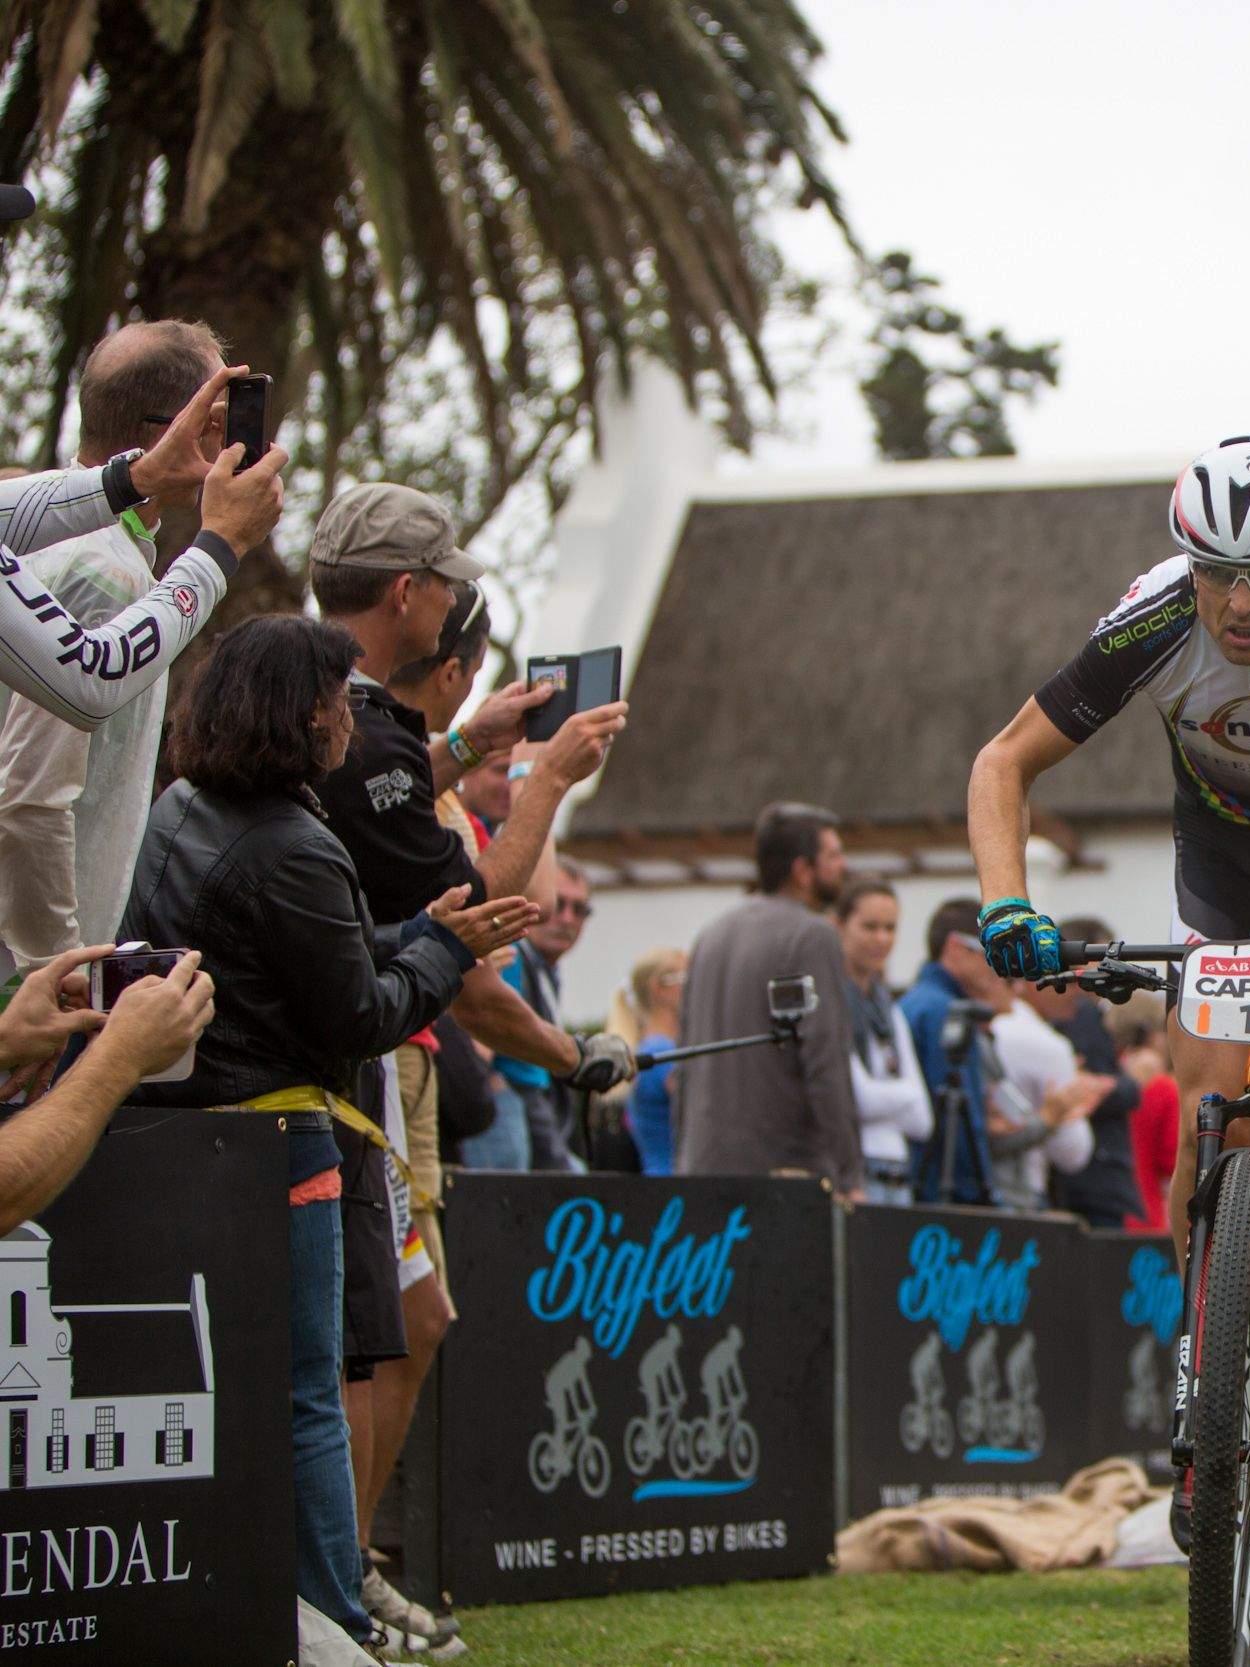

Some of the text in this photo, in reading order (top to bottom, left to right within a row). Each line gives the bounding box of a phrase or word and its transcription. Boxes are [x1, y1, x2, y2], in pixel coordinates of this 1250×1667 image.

[527, 1196, 752, 1360] Bigfeet
[1174, 1334, 1191, 1411] BRAIN
[0, 1519, 192, 1598] ENDAL
[494, 1538, 557, 1571] WINE
[581, 1528, 685, 1564] PRESSED
[690, 1526, 720, 1556] BY
[724, 1519, 788, 1549] BIKES
[0, 1615, 98, 1648] ESTATE
